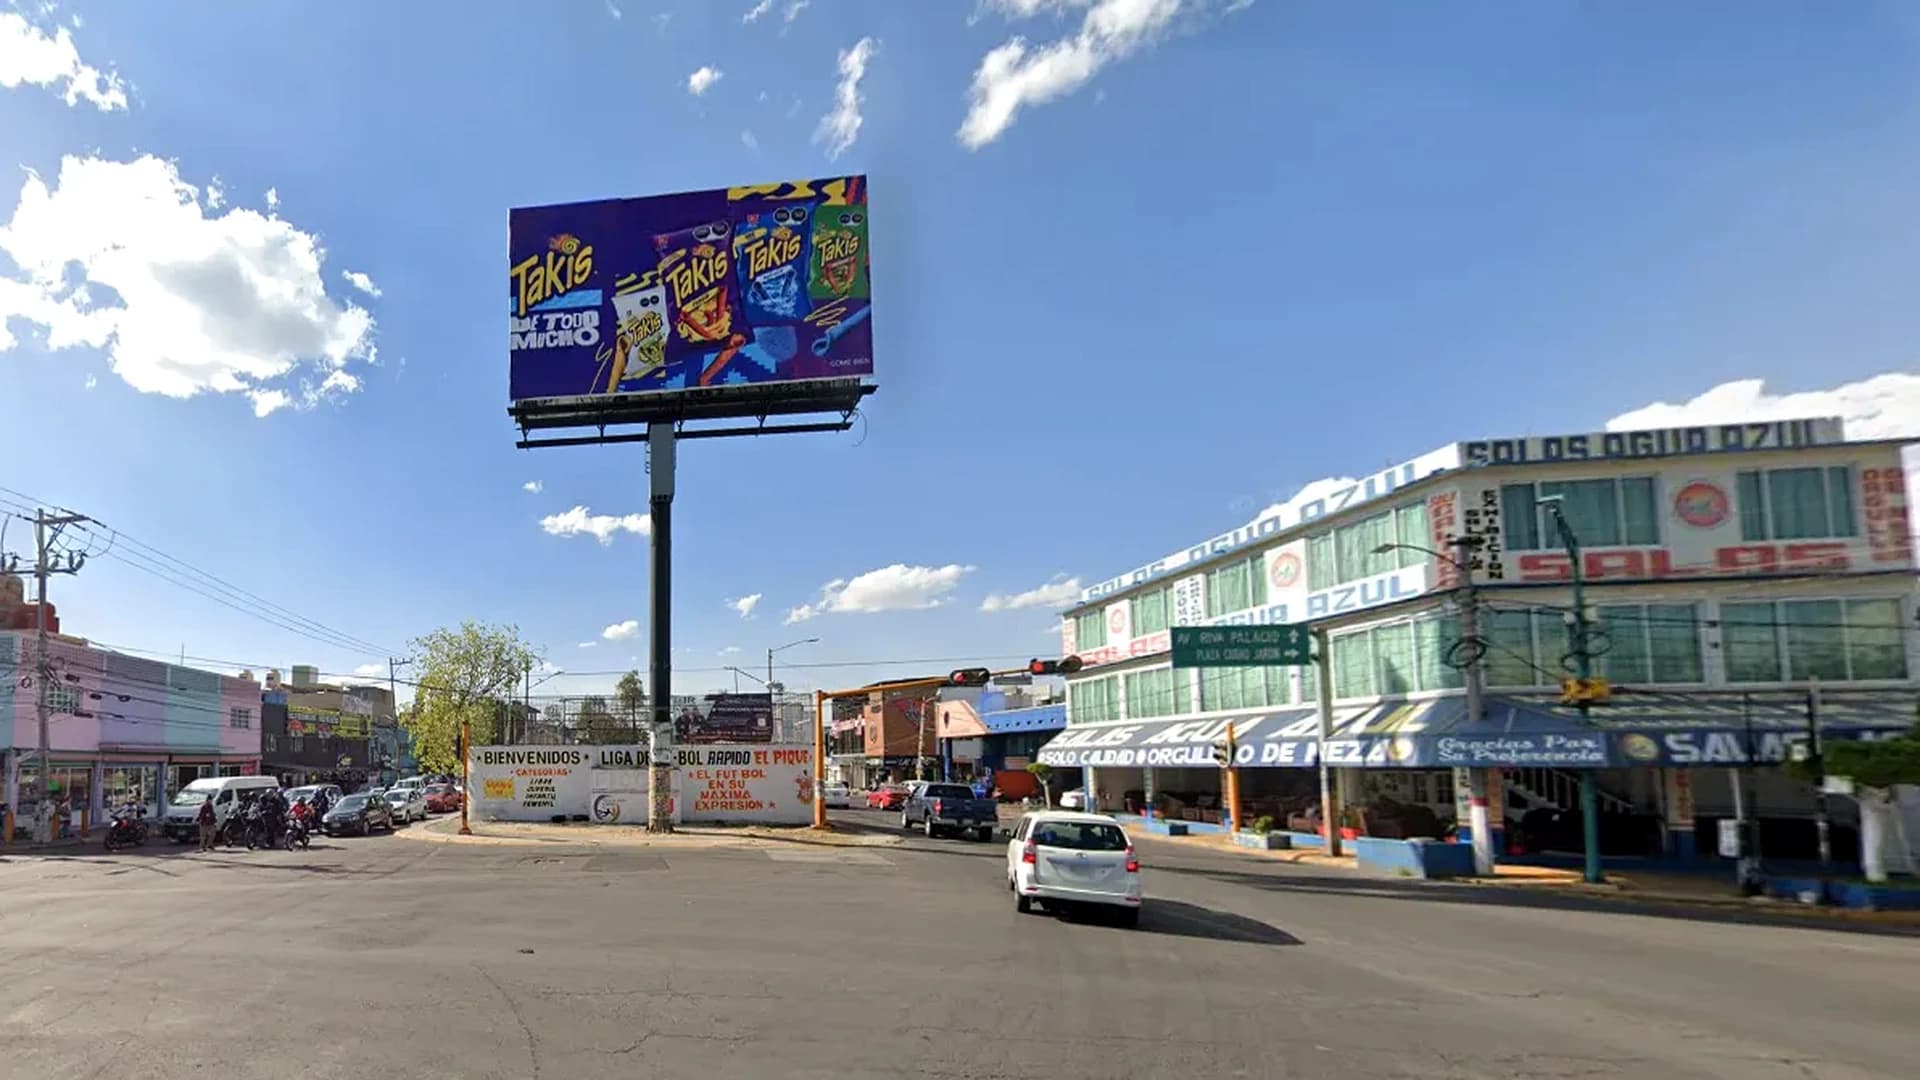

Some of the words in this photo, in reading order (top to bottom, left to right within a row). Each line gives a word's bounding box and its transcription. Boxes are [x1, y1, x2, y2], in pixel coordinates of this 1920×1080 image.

[744, 234, 801, 279] Takis
[818, 236, 858, 267] Takis
[511, 246, 593, 316] Takis
[665, 252, 728, 308] Takis
[511, 327, 600, 350] MUCHO
[628, 314, 663, 345] Takis
[1519, 544, 1851, 581] SALAS
[1305, 575, 1418, 617] AZUL
[1051, 726, 1143, 749] SALAS
[484, 751, 581, 765] BIENVENIDOS
[601, 751, 633, 766] LIGA
[707, 751, 750, 765] RAPIDO
[754, 749, 770, 765] EL
[1045, 751, 1076, 765] SOLO
[1261, 743, 1300, 763] DE
[515, 767, 568, 777] CATEGORIAS
[696, 770, 711, 780] EL
[716, 769, 737, 779] FUT
[741, 768, 766, 778] BOL
[700, 791, 751, 799] MAXIMA
[708, 780, 725, 789] EN
[729, 779, 745, 789] SU
[695, 801, 763, 811] EXPRESION
